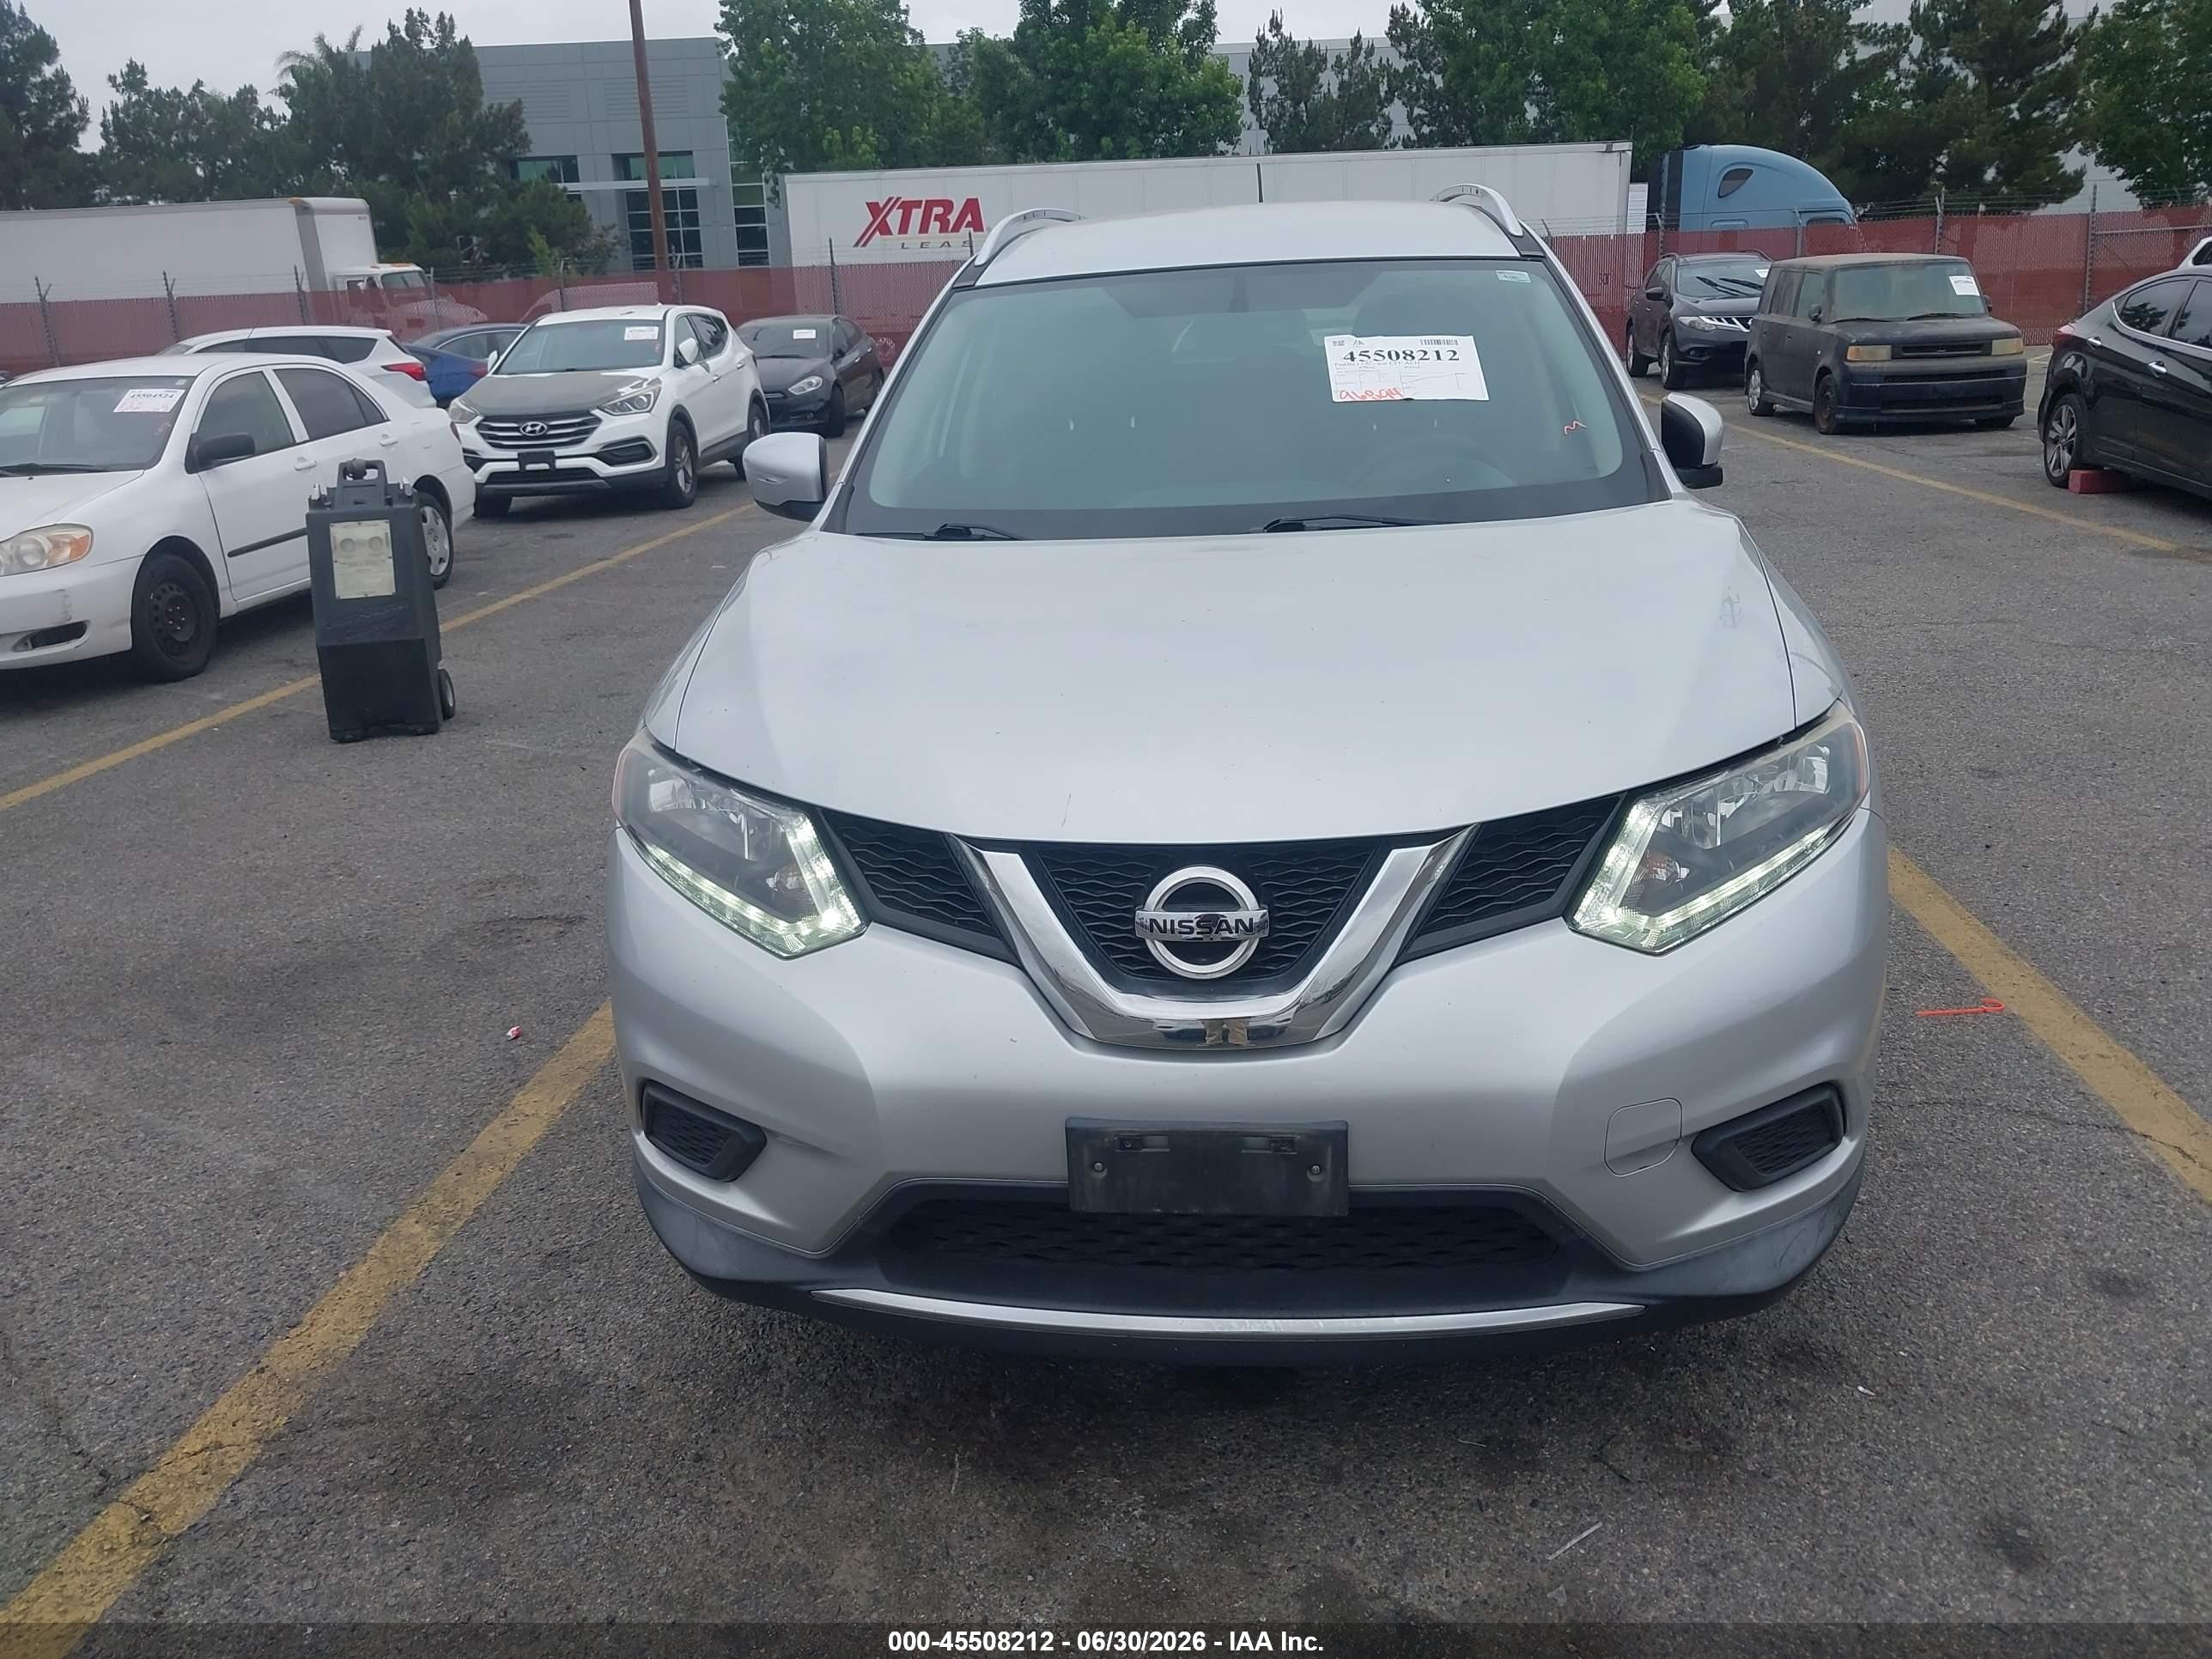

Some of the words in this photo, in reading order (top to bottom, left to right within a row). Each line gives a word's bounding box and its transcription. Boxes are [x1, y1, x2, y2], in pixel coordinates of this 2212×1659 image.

[853, 196, 985, 248] XTRA
[901, 240, 973, 250] LEAS
[1342, 349, 1461, 362] 45508212
[1149, 916, 1255, 935] NISSAN
